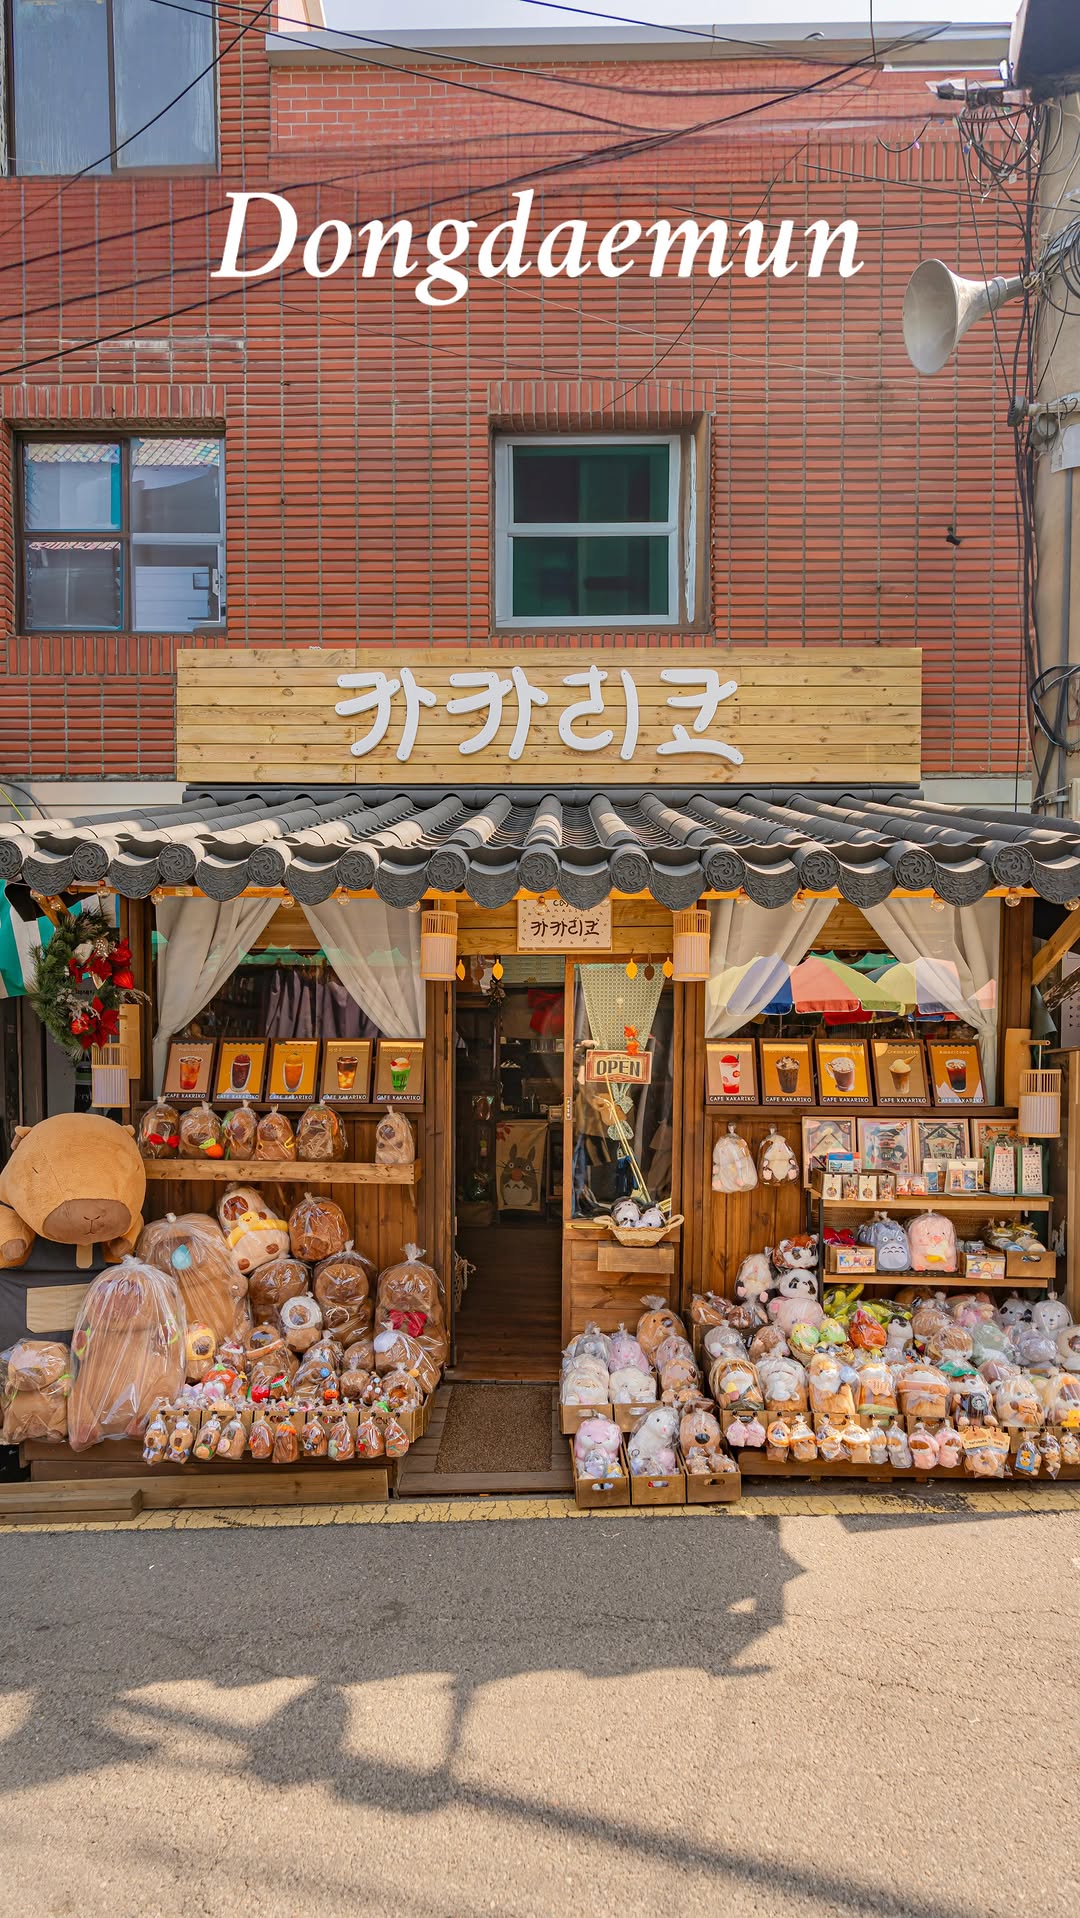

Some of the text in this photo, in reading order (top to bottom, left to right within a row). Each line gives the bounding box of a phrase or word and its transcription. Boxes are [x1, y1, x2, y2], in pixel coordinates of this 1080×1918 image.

[335, 665, 743, 764] 카카리코
[531, 919, 600, 937] 카카리코
[596, 1060, 641, 1077] OPEN
